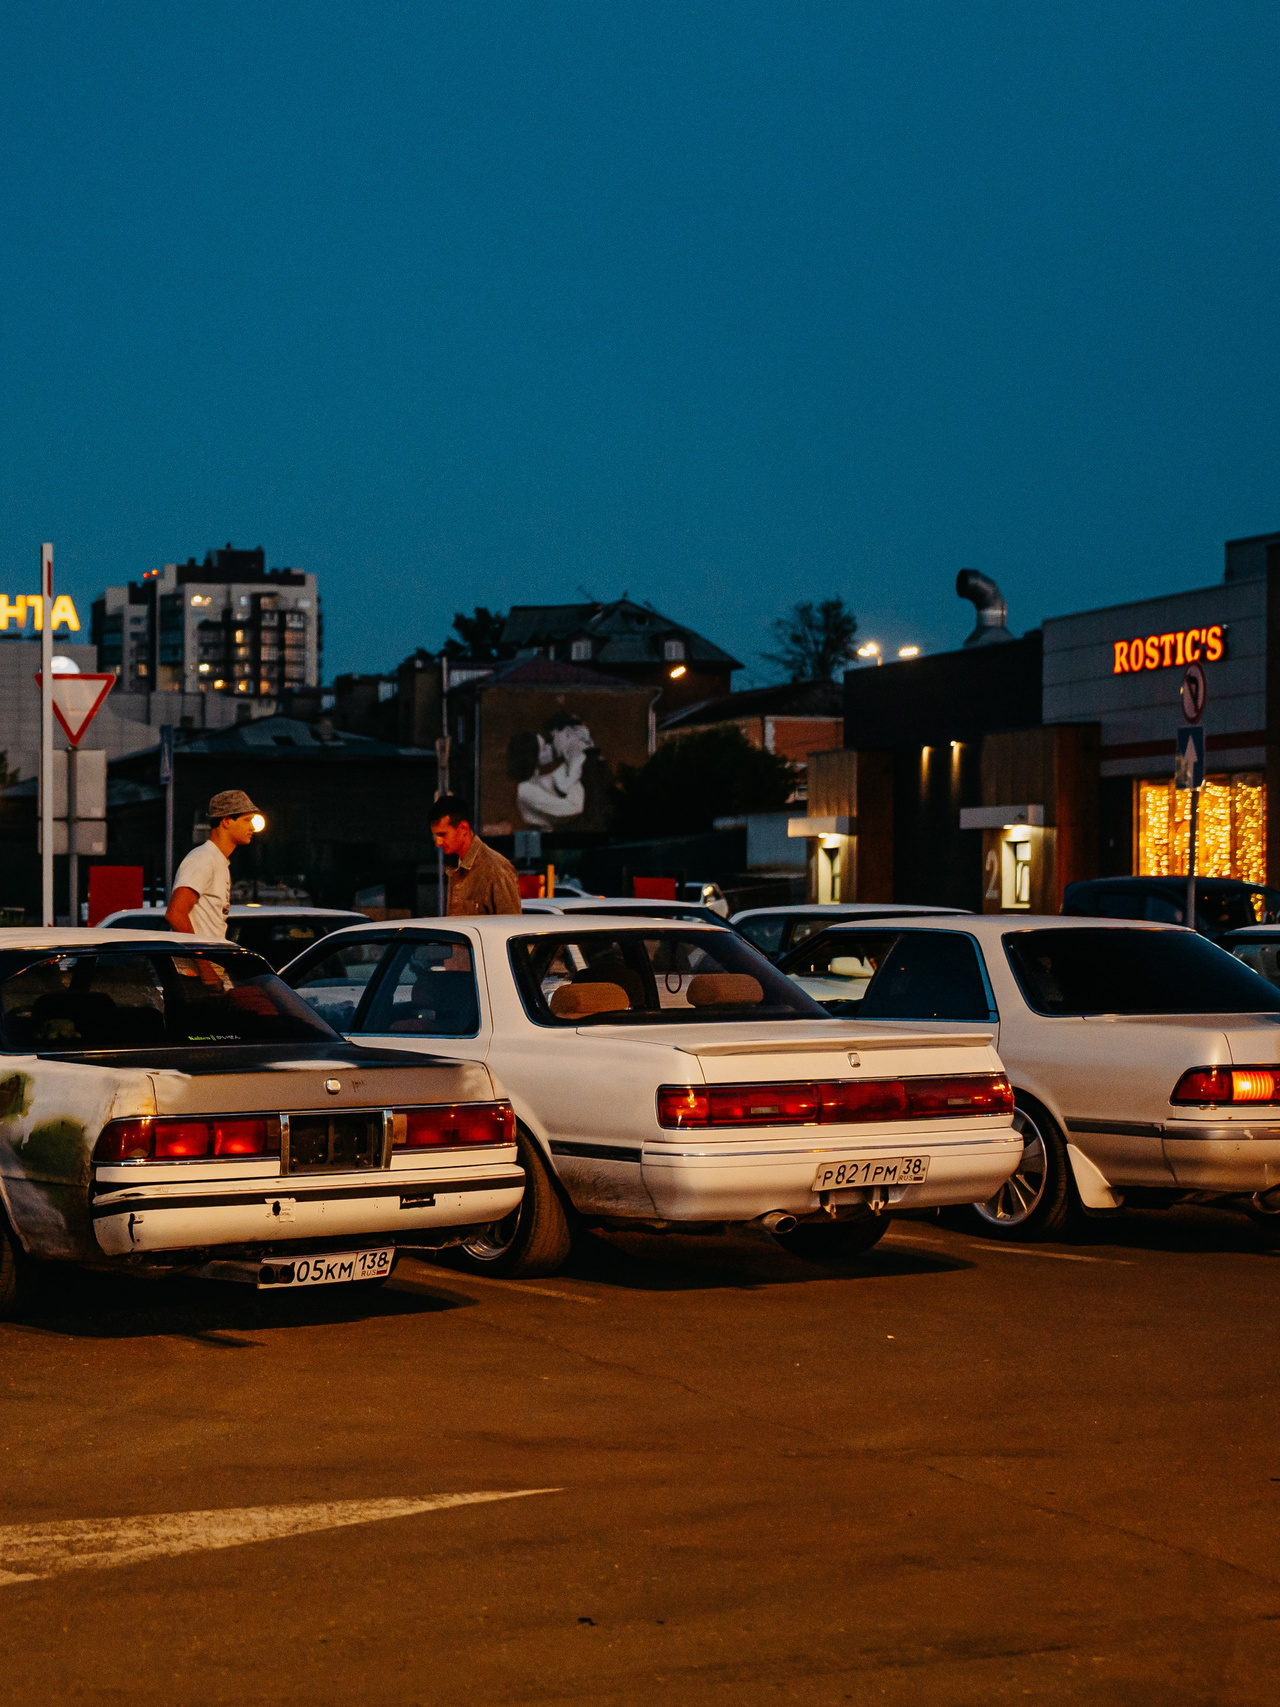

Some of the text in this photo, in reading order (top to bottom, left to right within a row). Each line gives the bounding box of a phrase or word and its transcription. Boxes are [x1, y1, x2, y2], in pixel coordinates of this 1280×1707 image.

[1113, 624, 1224, 674] ROSTIC'S
[985, 848, 999, 899] 2
[822, 1158, 922, 1186] Р821РМ 38
[899, 1174, 913, 1182] RUS
[358, 1251, 388, 1270] 138
[360, 1269, 377, 1277] RUS
